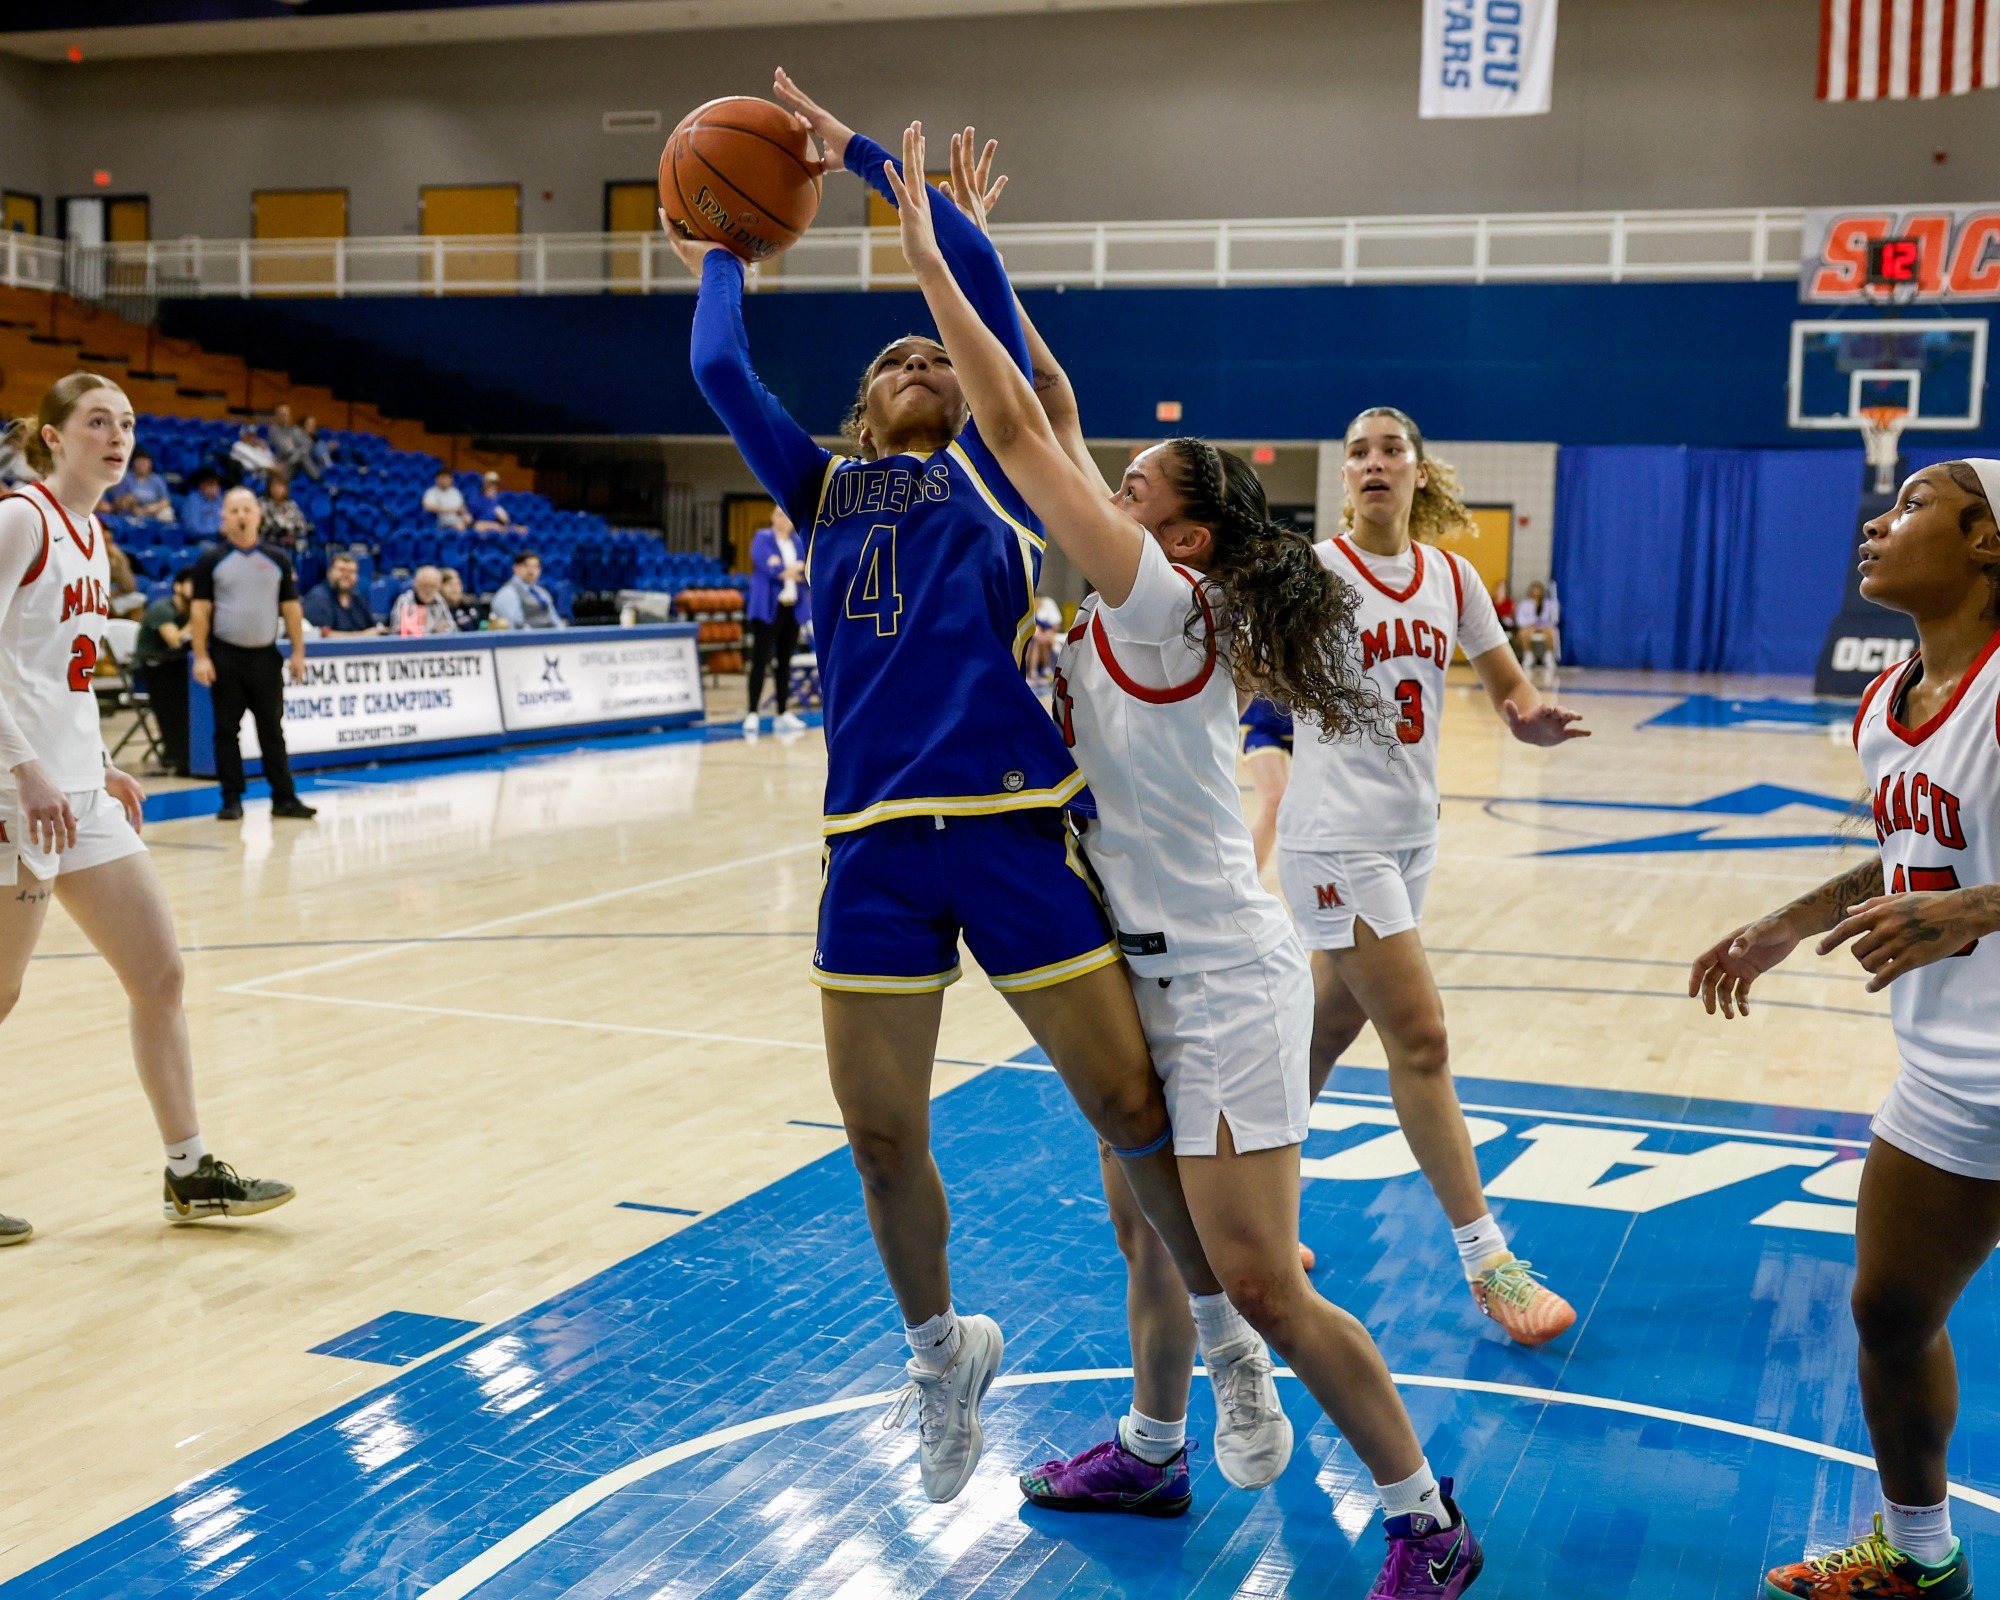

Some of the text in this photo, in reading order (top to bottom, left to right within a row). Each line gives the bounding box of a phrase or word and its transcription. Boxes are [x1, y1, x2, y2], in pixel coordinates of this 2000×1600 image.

[1484, 0, 1521, 92] OCU
[690, 185, 781, 257] SPALDING
[1881, 241, 1917, 279] 12
[816, 464, 949, 527] QUEENS
[846, 524, 902, 636] 4
[67, 634, 97, 692] 2
[344, 660, 381, 684] CITY
[387, 656, 482, 681] UNIVERSITY
[284, 688, 453, 720] HOME OF CHAMPIONS
[1395, 680, 1424, 743] 3
[1873, 771, 1968, 851] MACU
[1314, 882, 1345, 909] M
